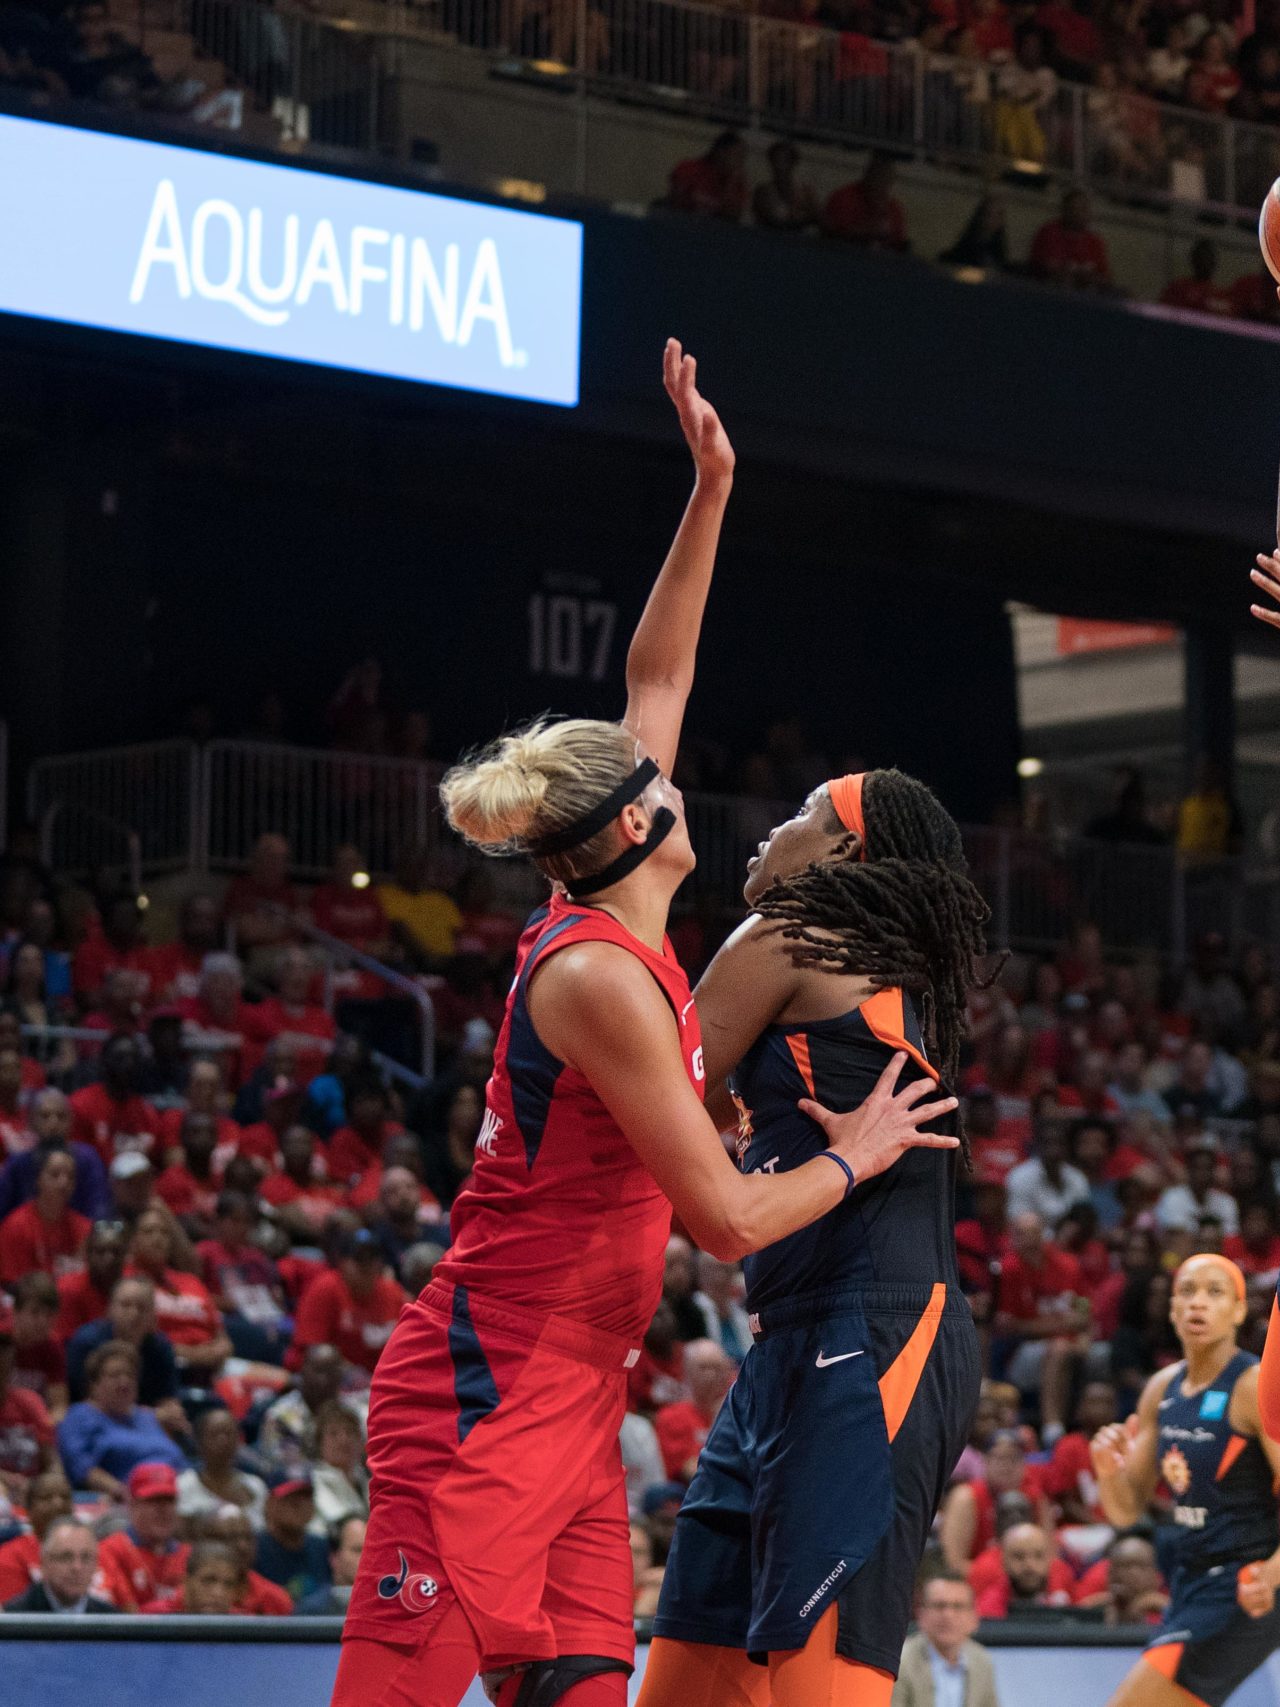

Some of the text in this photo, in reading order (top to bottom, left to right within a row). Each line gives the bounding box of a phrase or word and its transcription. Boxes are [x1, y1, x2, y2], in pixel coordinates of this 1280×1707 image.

[129, 178, 515, 368] AQUAFINA
[529, 594, 617, 680] 107
[799, 1559, 847, 1618] CONNECTICUT
